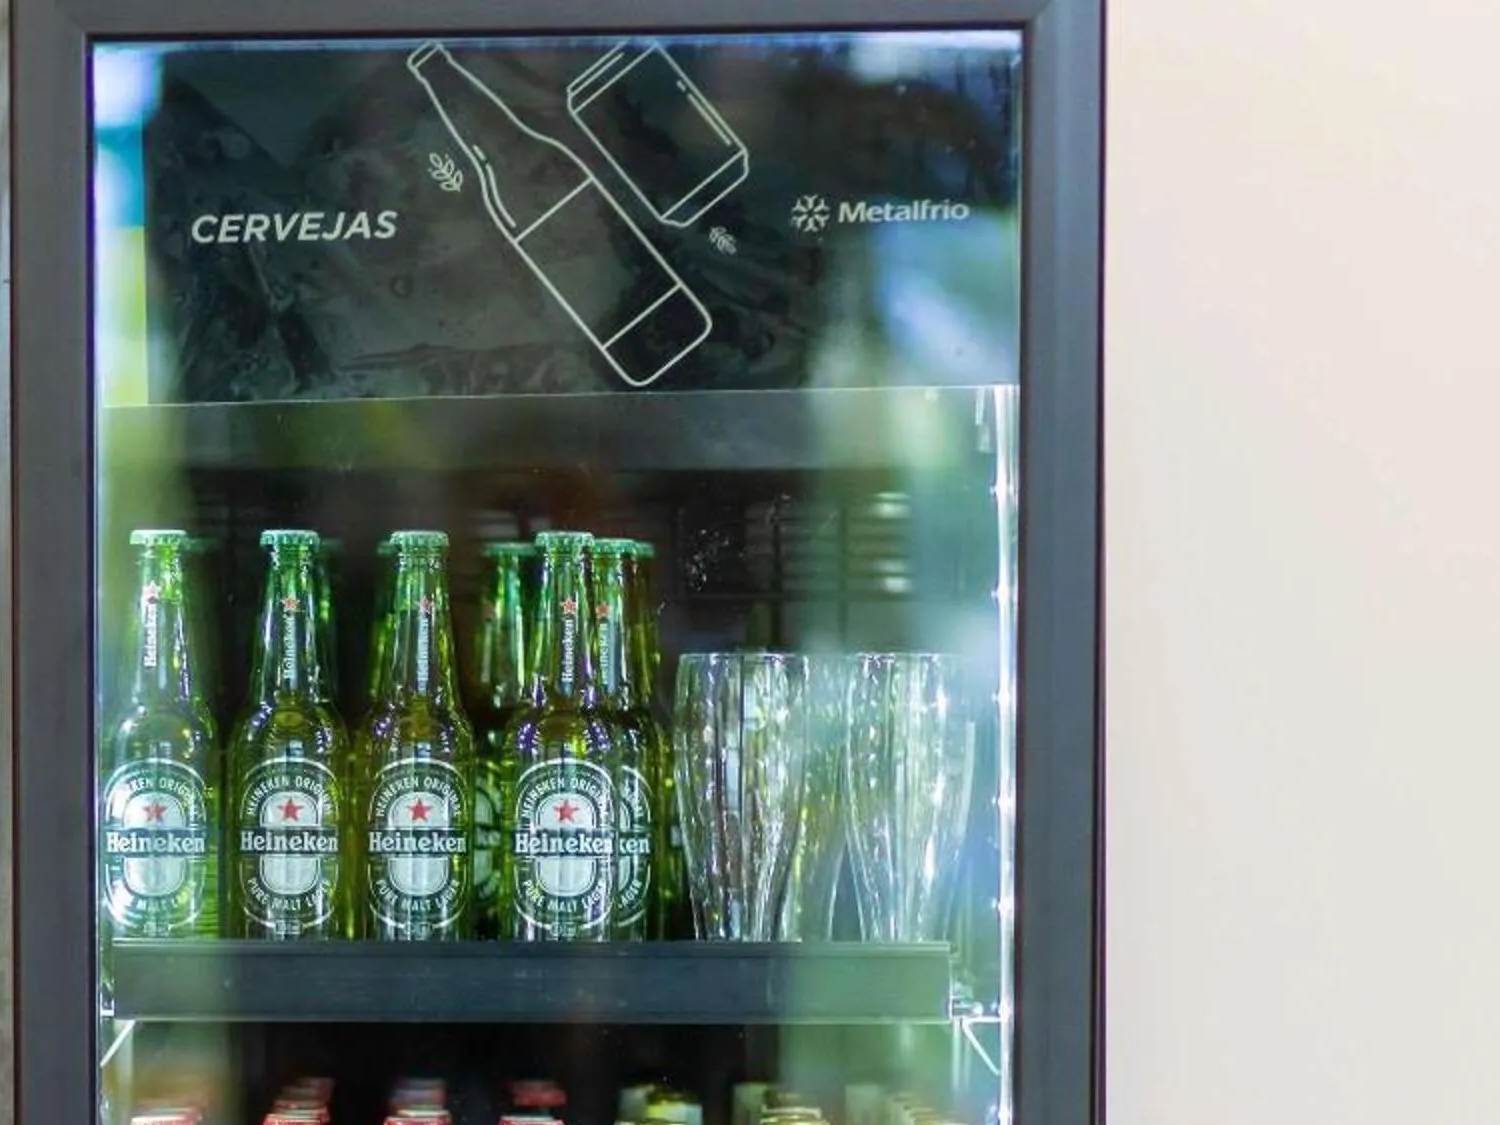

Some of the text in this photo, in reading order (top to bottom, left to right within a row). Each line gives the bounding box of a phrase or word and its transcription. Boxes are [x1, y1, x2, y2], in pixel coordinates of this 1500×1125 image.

[838, 199, 970, 223] Metalfrio
[191, 210, 398, 243] CERVEJAS
[562, 619, 575, 683] Heineken
[247, 775, 290, 815] HEINEKEN
[376, 777, 419, 817] HEINEKEN
[522, 778, 565, 819] HEINEKEN
[106, 831, 206, 853] Heineken
[241, 831, 339, 852] Heineken
[368, 831, 467, 852] Heineken
[515, 832, 614, 853] Heineken
